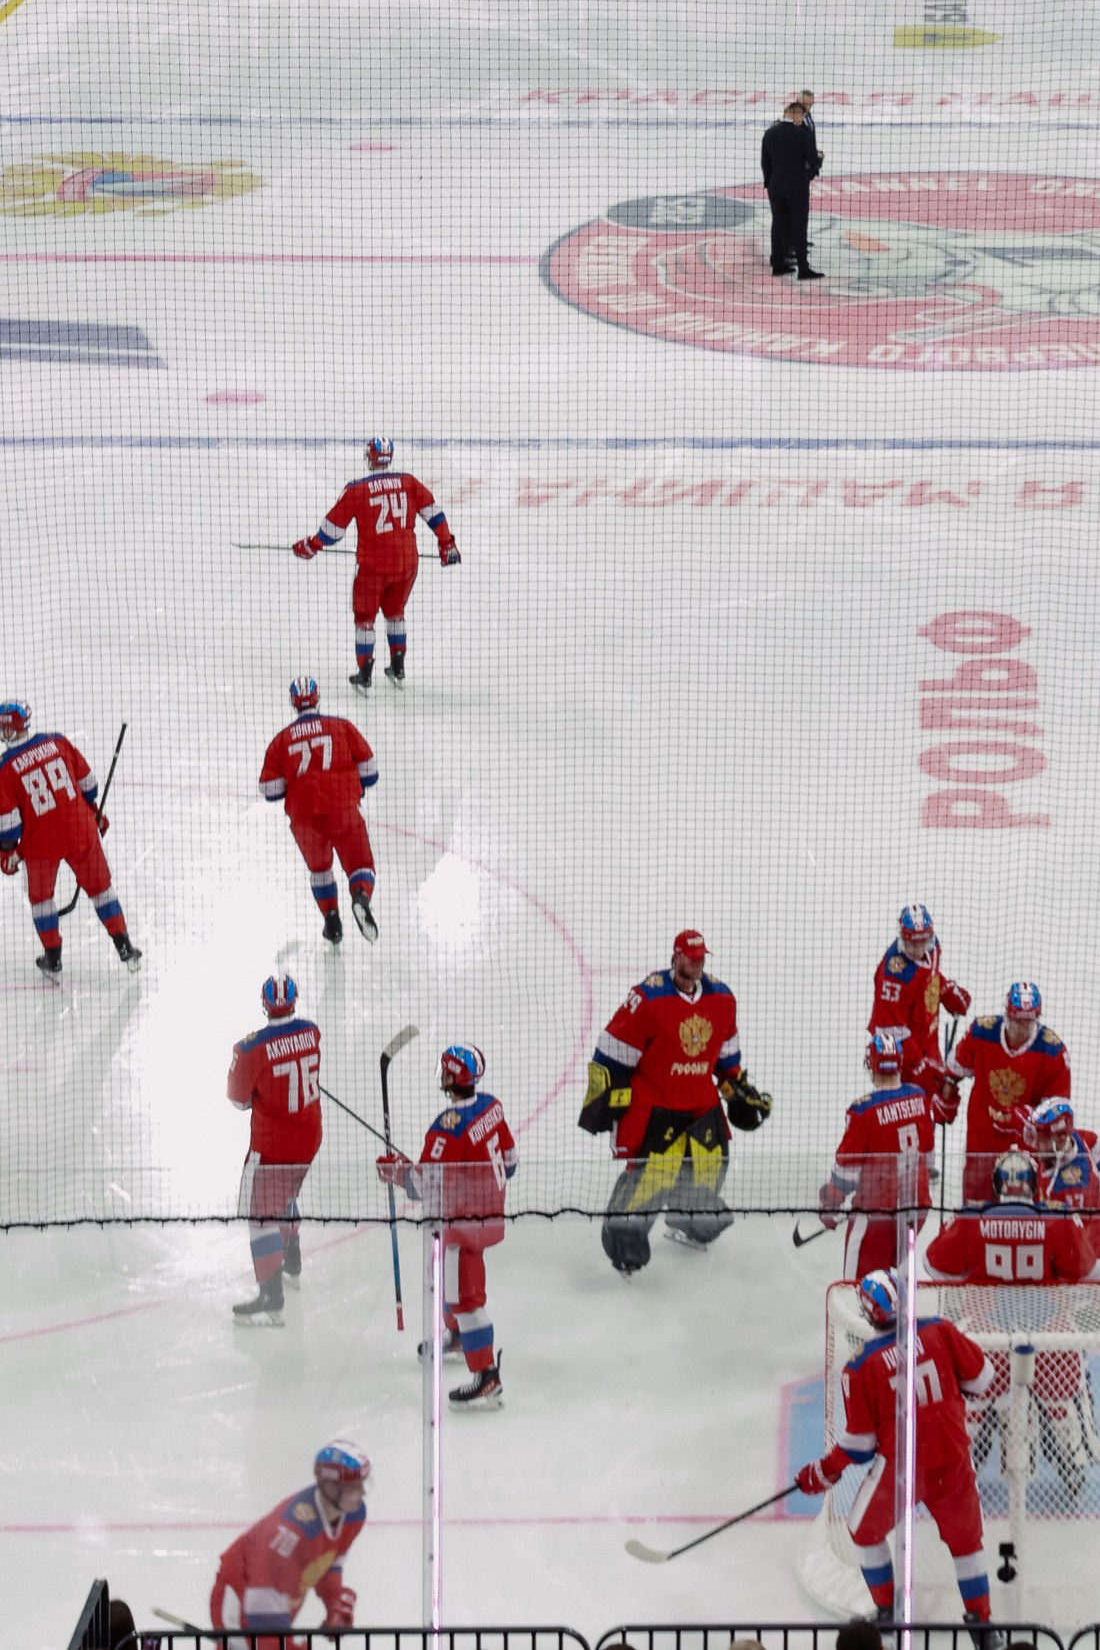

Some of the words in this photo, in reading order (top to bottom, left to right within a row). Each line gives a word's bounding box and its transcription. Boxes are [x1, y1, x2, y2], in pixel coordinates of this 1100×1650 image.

[521, 89, 914, 106] КРАСНАЯ
[811, 177, 996, 198] HANNEL
[649, 311, 847, 356] КАНАЛА
[368, 477, 402, 495] SAFONOV
[516, 478, 985, 508] МАШИНА
[369, 492, 408, 534] 24
[916, 611, 1051, 828] РОЛЬФ
[11, 741, 59, 773] KARPUKHIN
[288, 734, 333, 778] 77
[21, 757, 77, 817] 89
[880, 981, 902, 1002] 53
[266, 1030, 316, 1062] AKHIYAROV
[272, 1052, 320, 1114] 76
[877, 1094, 926, 1126] KANTSEROV
[430, 1137, 447, 1161] 6
[979, 1219, 1046, 1240] MOTORYGIN
[985, 1243, 1045, 1281] 99
